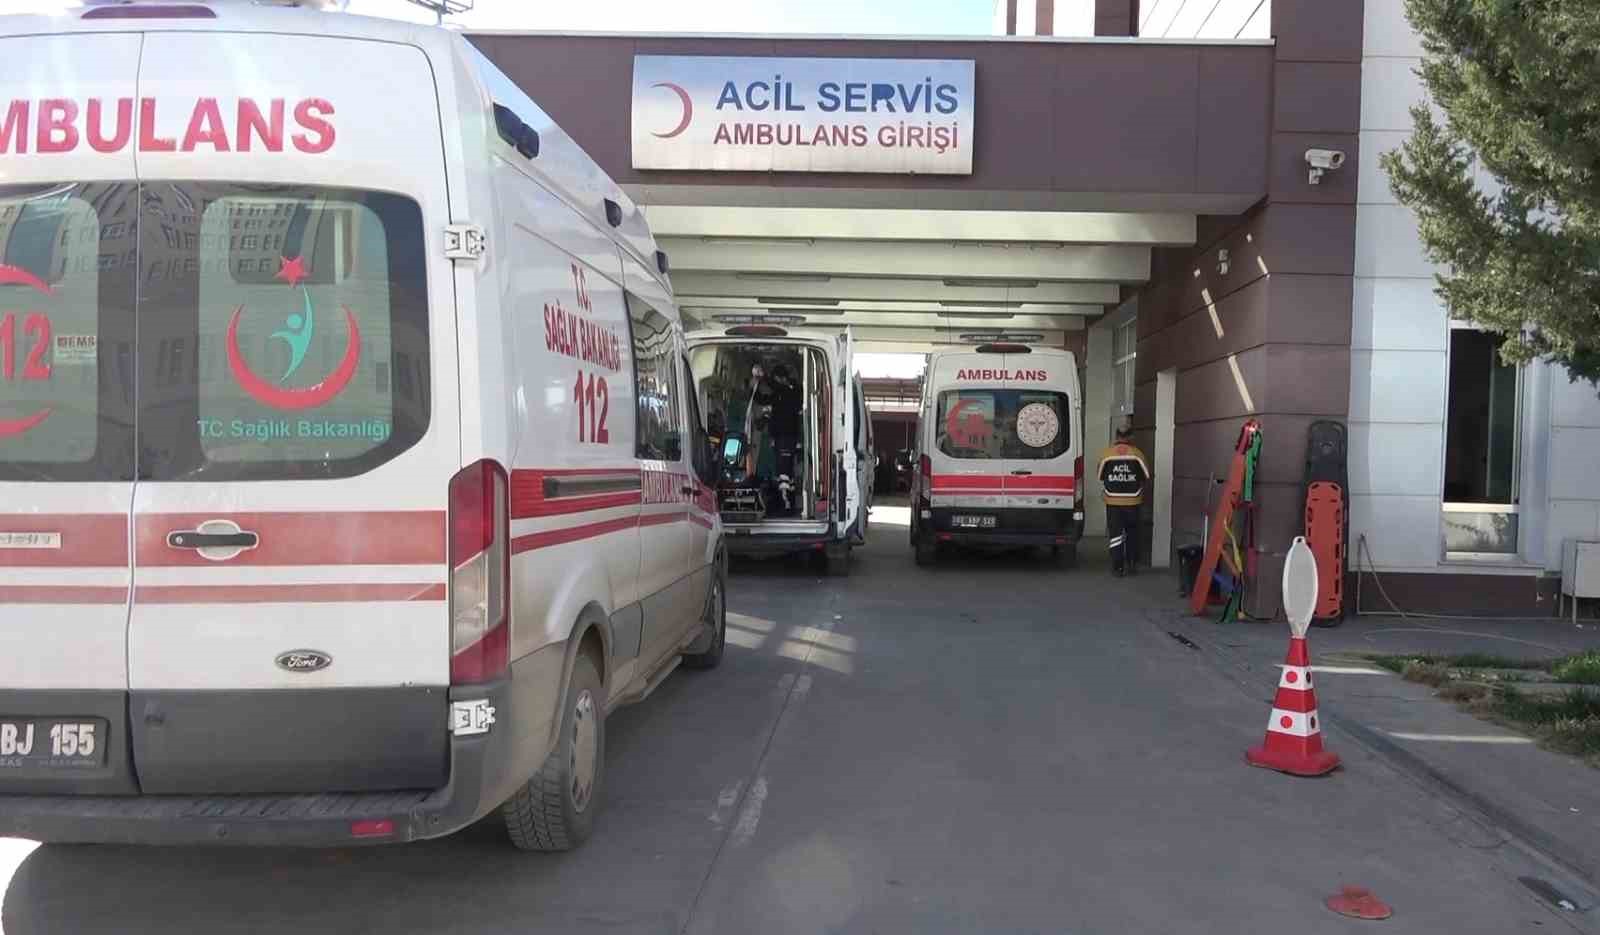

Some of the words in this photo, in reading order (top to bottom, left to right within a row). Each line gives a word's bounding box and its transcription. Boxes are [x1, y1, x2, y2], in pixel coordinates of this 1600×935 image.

[715, 74, 806, 112] ACİL
[817, 77, 959, 115] SERVİS
[713, 123, 868, 148] AMBULANS
[877, 122, 959, 154] GİRİŞİ
[544, 299, 580, 360] SAĞLIK
[956, 368, 1047, 381] AMBULANS
[574, 369, 609, 444] 112
[231, 419, 291, 441] Sağlık
[299, 419, 391, 441] Bakanlığı
[1113, 464, 1131, 472] ACİL
[287, 655, 318, 668] Ford
[1, 723, 34, 756] BJ
[50, 723, 96, 757] 155
